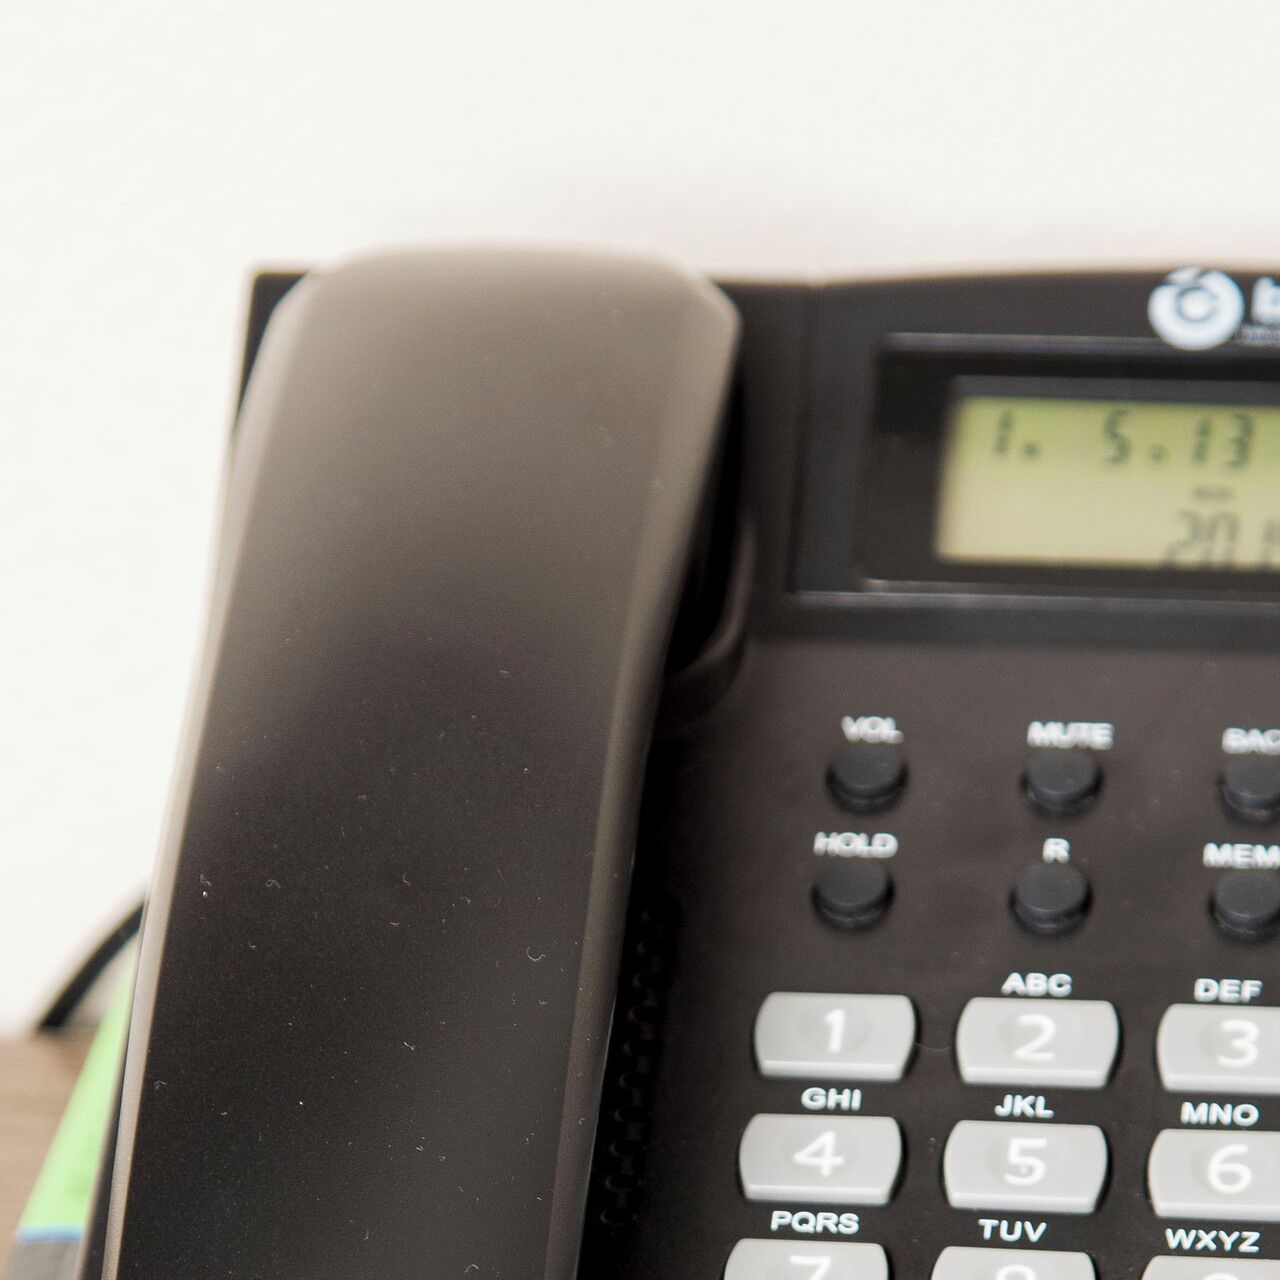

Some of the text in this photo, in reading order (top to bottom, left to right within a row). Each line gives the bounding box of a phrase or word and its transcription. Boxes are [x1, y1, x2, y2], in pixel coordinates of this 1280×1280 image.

[842, 716, 901, 743] VOL
[1027, 721, 1113, 749] MUTE
[813, 831, 898, 858] HOLD
[1042, 837, 1070, 862] R
[1001, 972, 1072, 997] ABC
[1193, 978, 1263, 1003] DEF
[826, 1009, 845, 1052] 1
[1016, 1014, 1056, 1060] 2
[1219, 1020, 1259, 1066] 3
[801, 1087, 862, 1110] GHI
[994, 1094, 1054, 1118] JKL
[1180, 1101, 1259, 1126] MNO
[795, 1131, 844, 1176] 4
[1006, 1137, 1047, 1185] 5
[1209, 1144, 1252, 1193] 6
[770, 1210, 859, 1235] PQRS
[978, 1218, 1047, 1242] TUV
[1165, 1228, 1260, 1253] WXYZ
